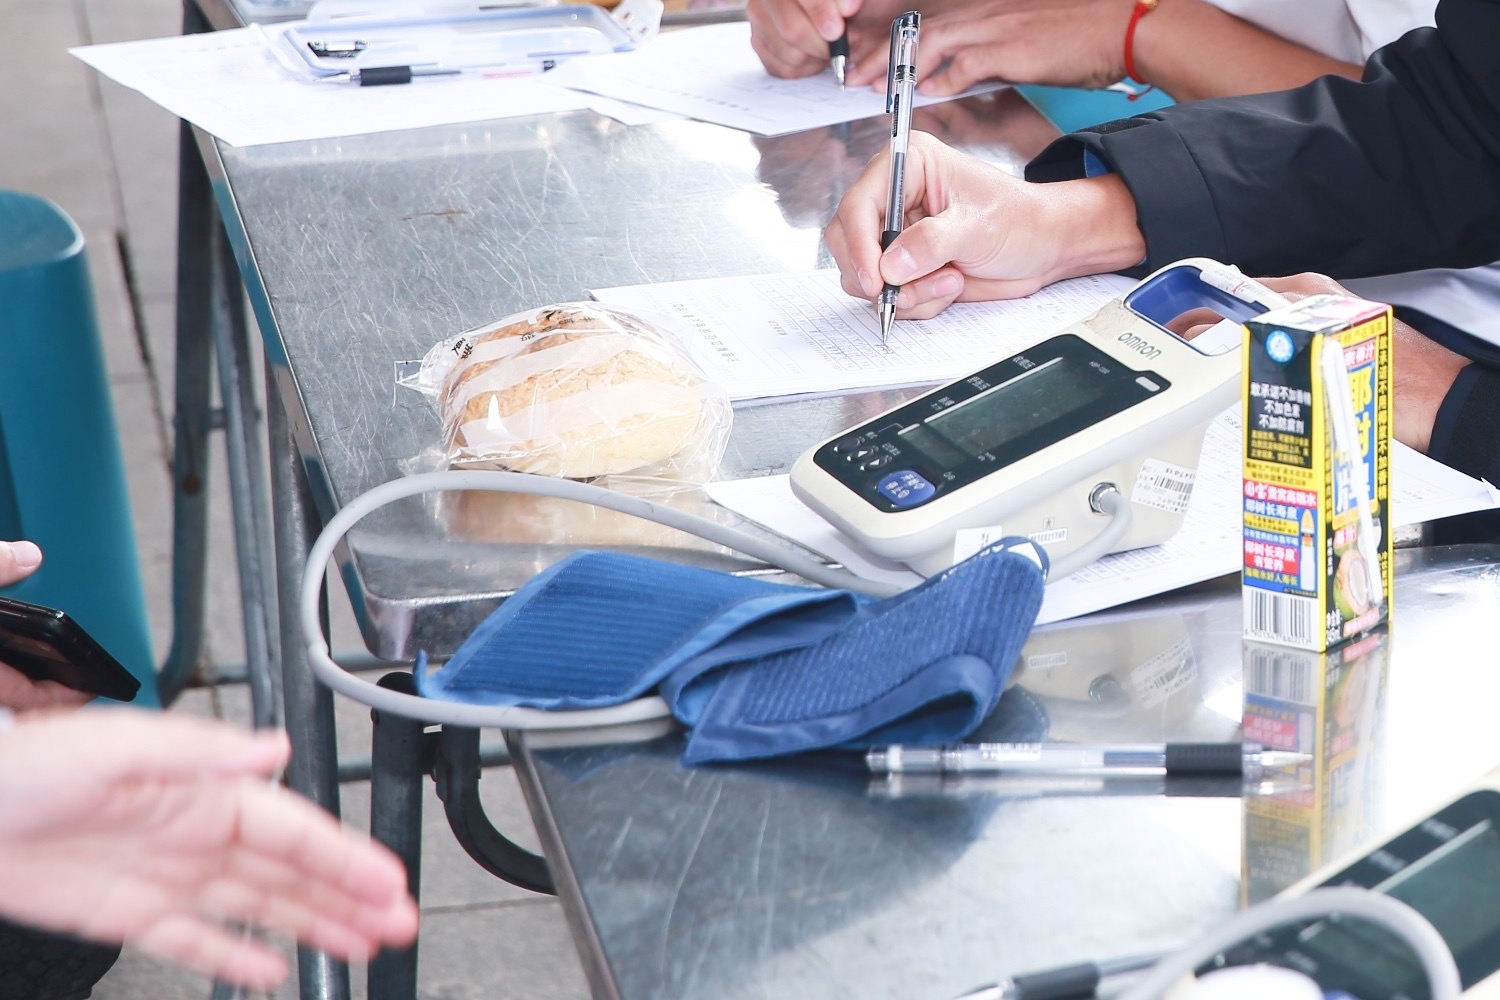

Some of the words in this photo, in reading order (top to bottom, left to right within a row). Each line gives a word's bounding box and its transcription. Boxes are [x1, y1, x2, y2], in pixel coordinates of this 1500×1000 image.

[1263, 399, 1301, 419] 不加色素
[1258, 413, 1304, 435] 不加防腐剂
[1245, 499, 1298, 521] 椰树长寿泉
[1245, 540, 1296, 563] 椰树长寿泉
[1253, 555, 1284, 572] 有营养
